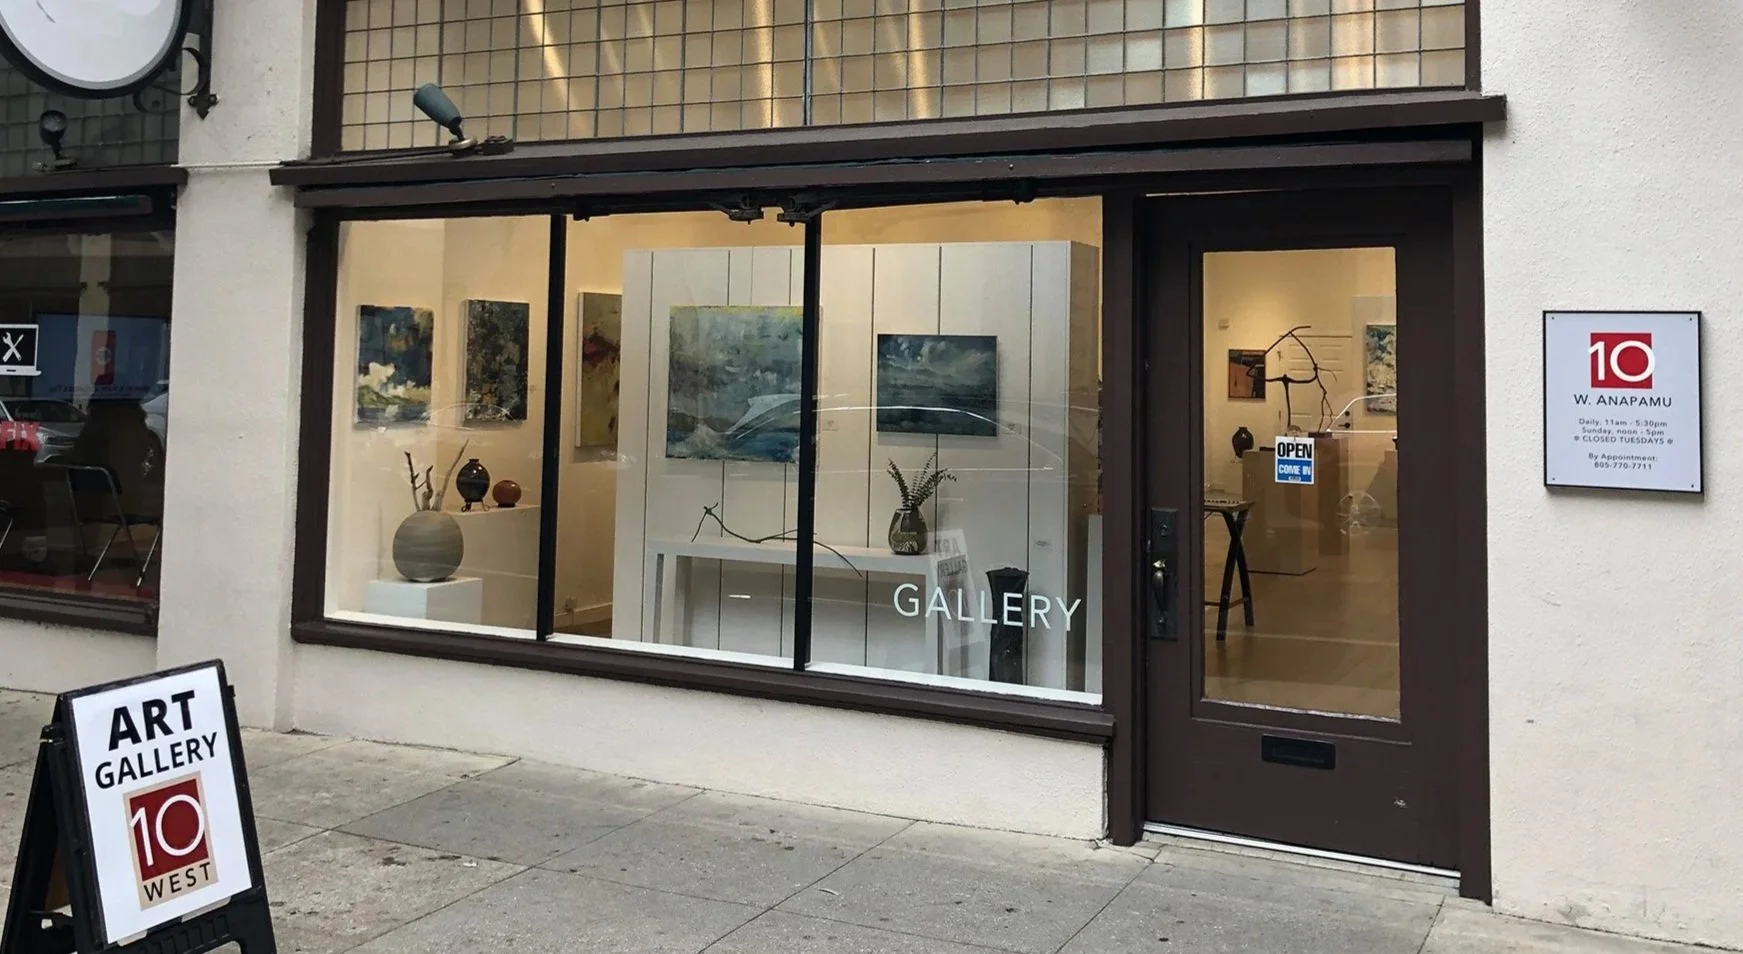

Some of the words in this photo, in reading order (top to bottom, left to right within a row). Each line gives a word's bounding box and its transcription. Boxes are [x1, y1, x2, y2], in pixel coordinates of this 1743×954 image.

[1588, 340, 1656, 382] 10
[1574, 394, 1591, 405] W.
[1597, 394, 1673, 407] ANAPAMU
[1636, 420, 1668, 428] 5:30pm
[1583, 435, 1617, 443] CLOSED
[1620, 436, 1665, 445] TUESDAYS
[1646, 429, 1665, 437] 5pm
[1278, 442, 1312, 459] OPEN
[1588, 452, 1599, 460] By
[1279, 464, 1301, 475] COME
[1302, 466, 1312, 476] IN
[893, 583, 1082, 632] GALLERY
[108, 690, 195, 752] ART
[95, 731, 217, 790] GALLERY
[129, 794, 206, 867] 10
[143, 861, 211, 903] WEST
